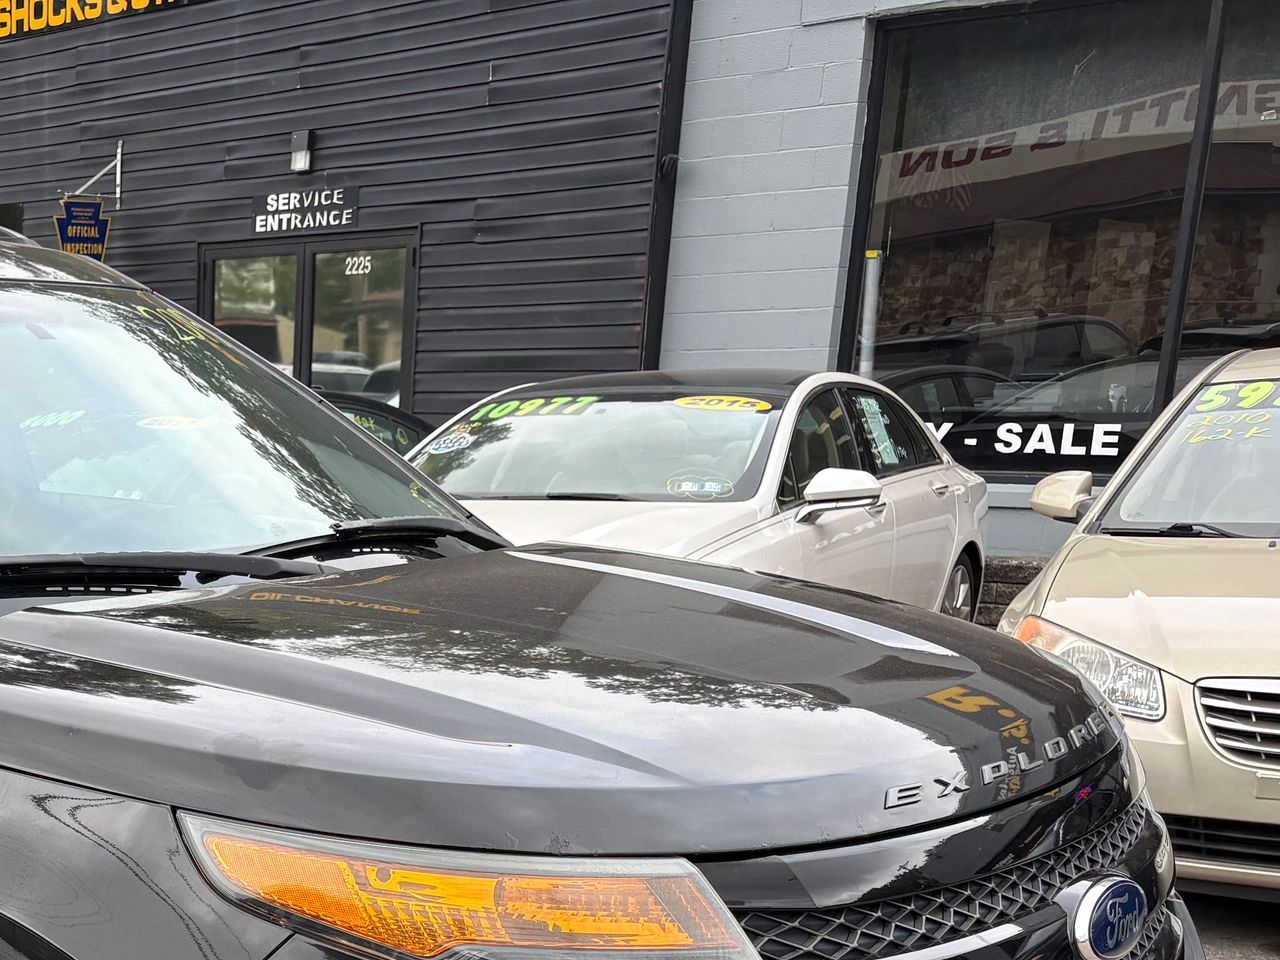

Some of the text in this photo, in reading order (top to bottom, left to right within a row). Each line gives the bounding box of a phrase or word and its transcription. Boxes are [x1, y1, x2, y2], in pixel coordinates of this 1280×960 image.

[266, 189, 344, 211] SERVICE
[67, 225, 100, 238] OFFICIAL
[255, 209, 353, 232] ENTRANCE
[63, 243, 103, 255] INSPECTION
[345, 256, 372, 275] 2225
[1195, 381, 1280, 412] 59
[470, 396, 600, 421] 10977
[1187, 411, 1272, 428] 2010
[994, 423, 1121, 456] SALE
[1106, 892, 1140, 949] Ford
